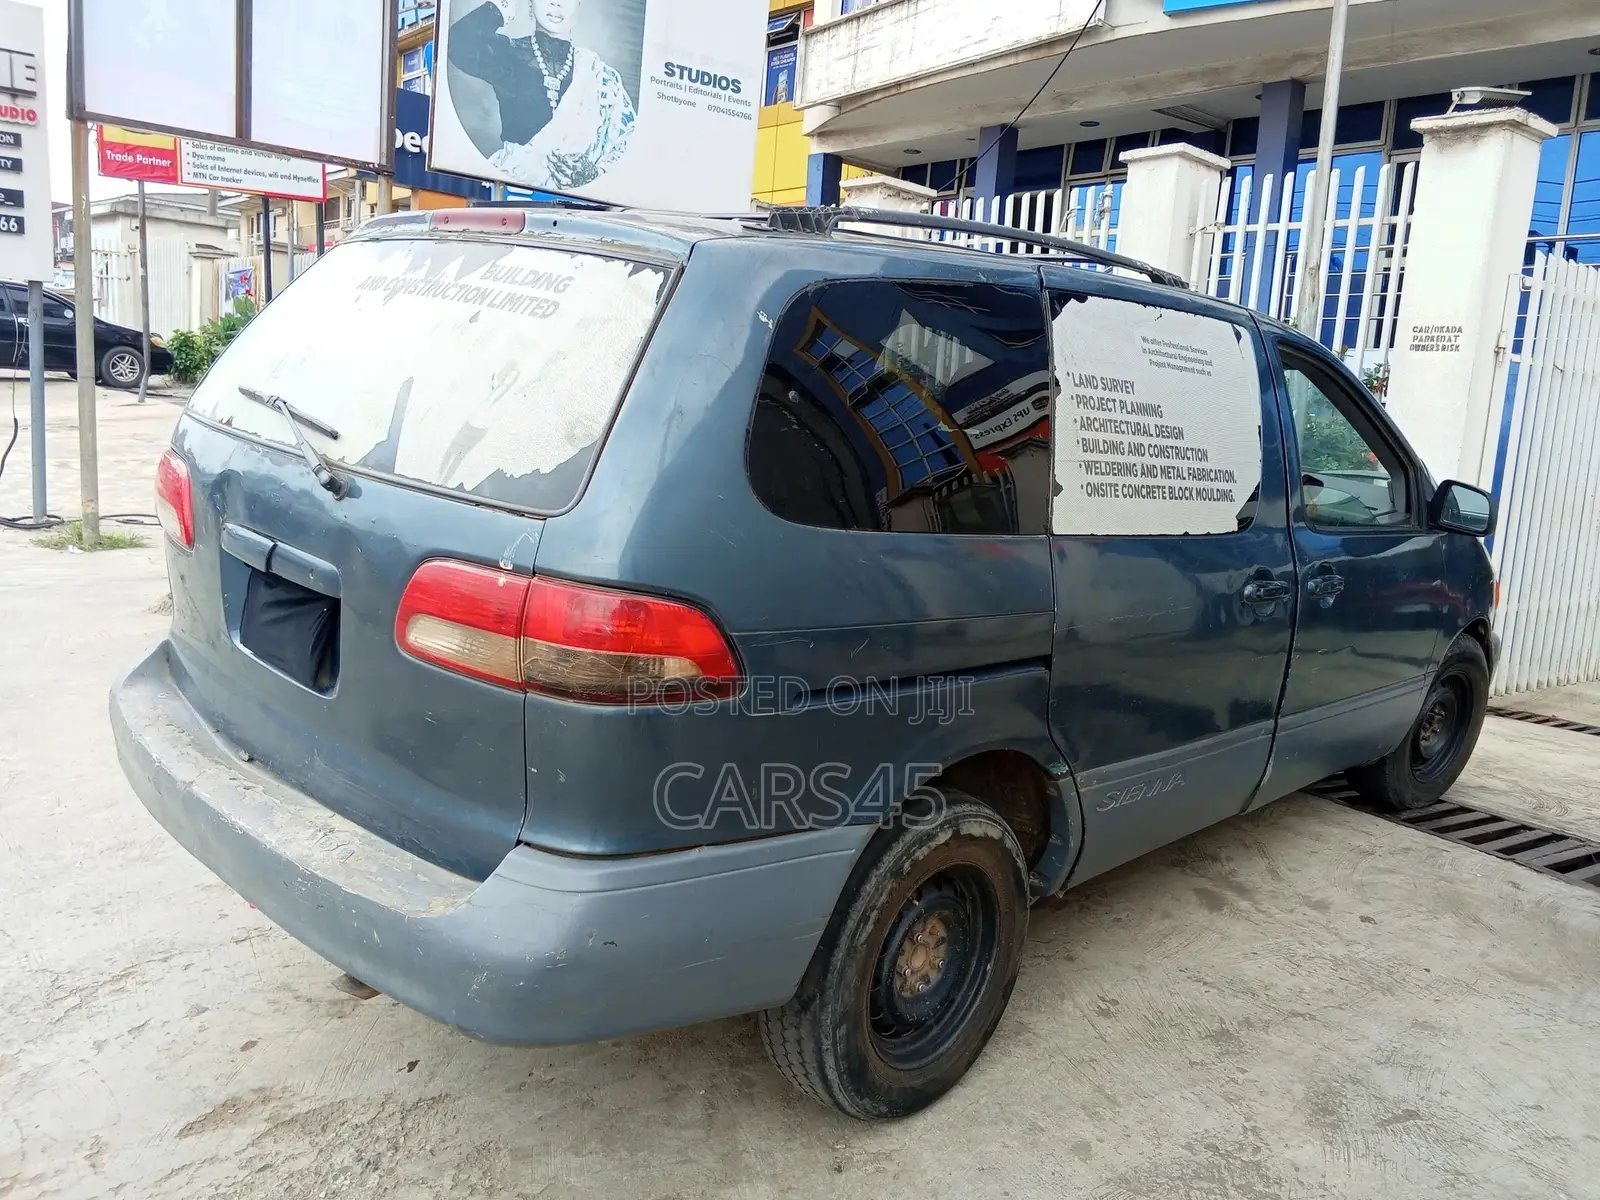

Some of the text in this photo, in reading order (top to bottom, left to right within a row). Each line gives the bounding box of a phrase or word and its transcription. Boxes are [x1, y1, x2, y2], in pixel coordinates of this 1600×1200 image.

[664, 62, 742, 94] STUDIOS
[650, 76, 682, 90] Portraits
[689, 86, 722, 100] Editorials
[728, 96, 752, 107] Events
[657, 92, 752, 120] Shotbyone 07041554766
[106, 150, 172, 167] Trade Partner
[192, 142, 208, 150] Sales
[217, 146, 239, 154] airtime
[192, 162, 209, 170] Sales
[218, 165, 242, 174] Internet
[480, 262, 575, 294] BUILDING
[356, 275, 560, 319] AND CONSTRUCTION LIMITED
[1412, 325, 1463, 334] CAR/OKADA
[1141, 336, 1208, 356] We offer Professional Services
[1148, 348, 1178, 360] Architectural
[1178, 353, 1204, 366] Engineering
[1149, 358, 1166, 369] Project
[1167, 361, 1196, 373] Management
[1072, 372, 1135, 395] LAND SURVEY
[1076, 394, 1164, 419] PROJECT PLANNING
[1080, 416, 1184, 440] ARCHITECTURAL DESIGN
[1081, 437, 1209, 462] BUILDING AND CONSTRUCTION
[1084, 460, 1237, 484] WELDERING AND METAL FABRICATION.
[1085, 482, 1236, 502] ONSITE CONCRETE BLOCK MOULDING.
[1096, 772, 1185, 812] SIENNA
